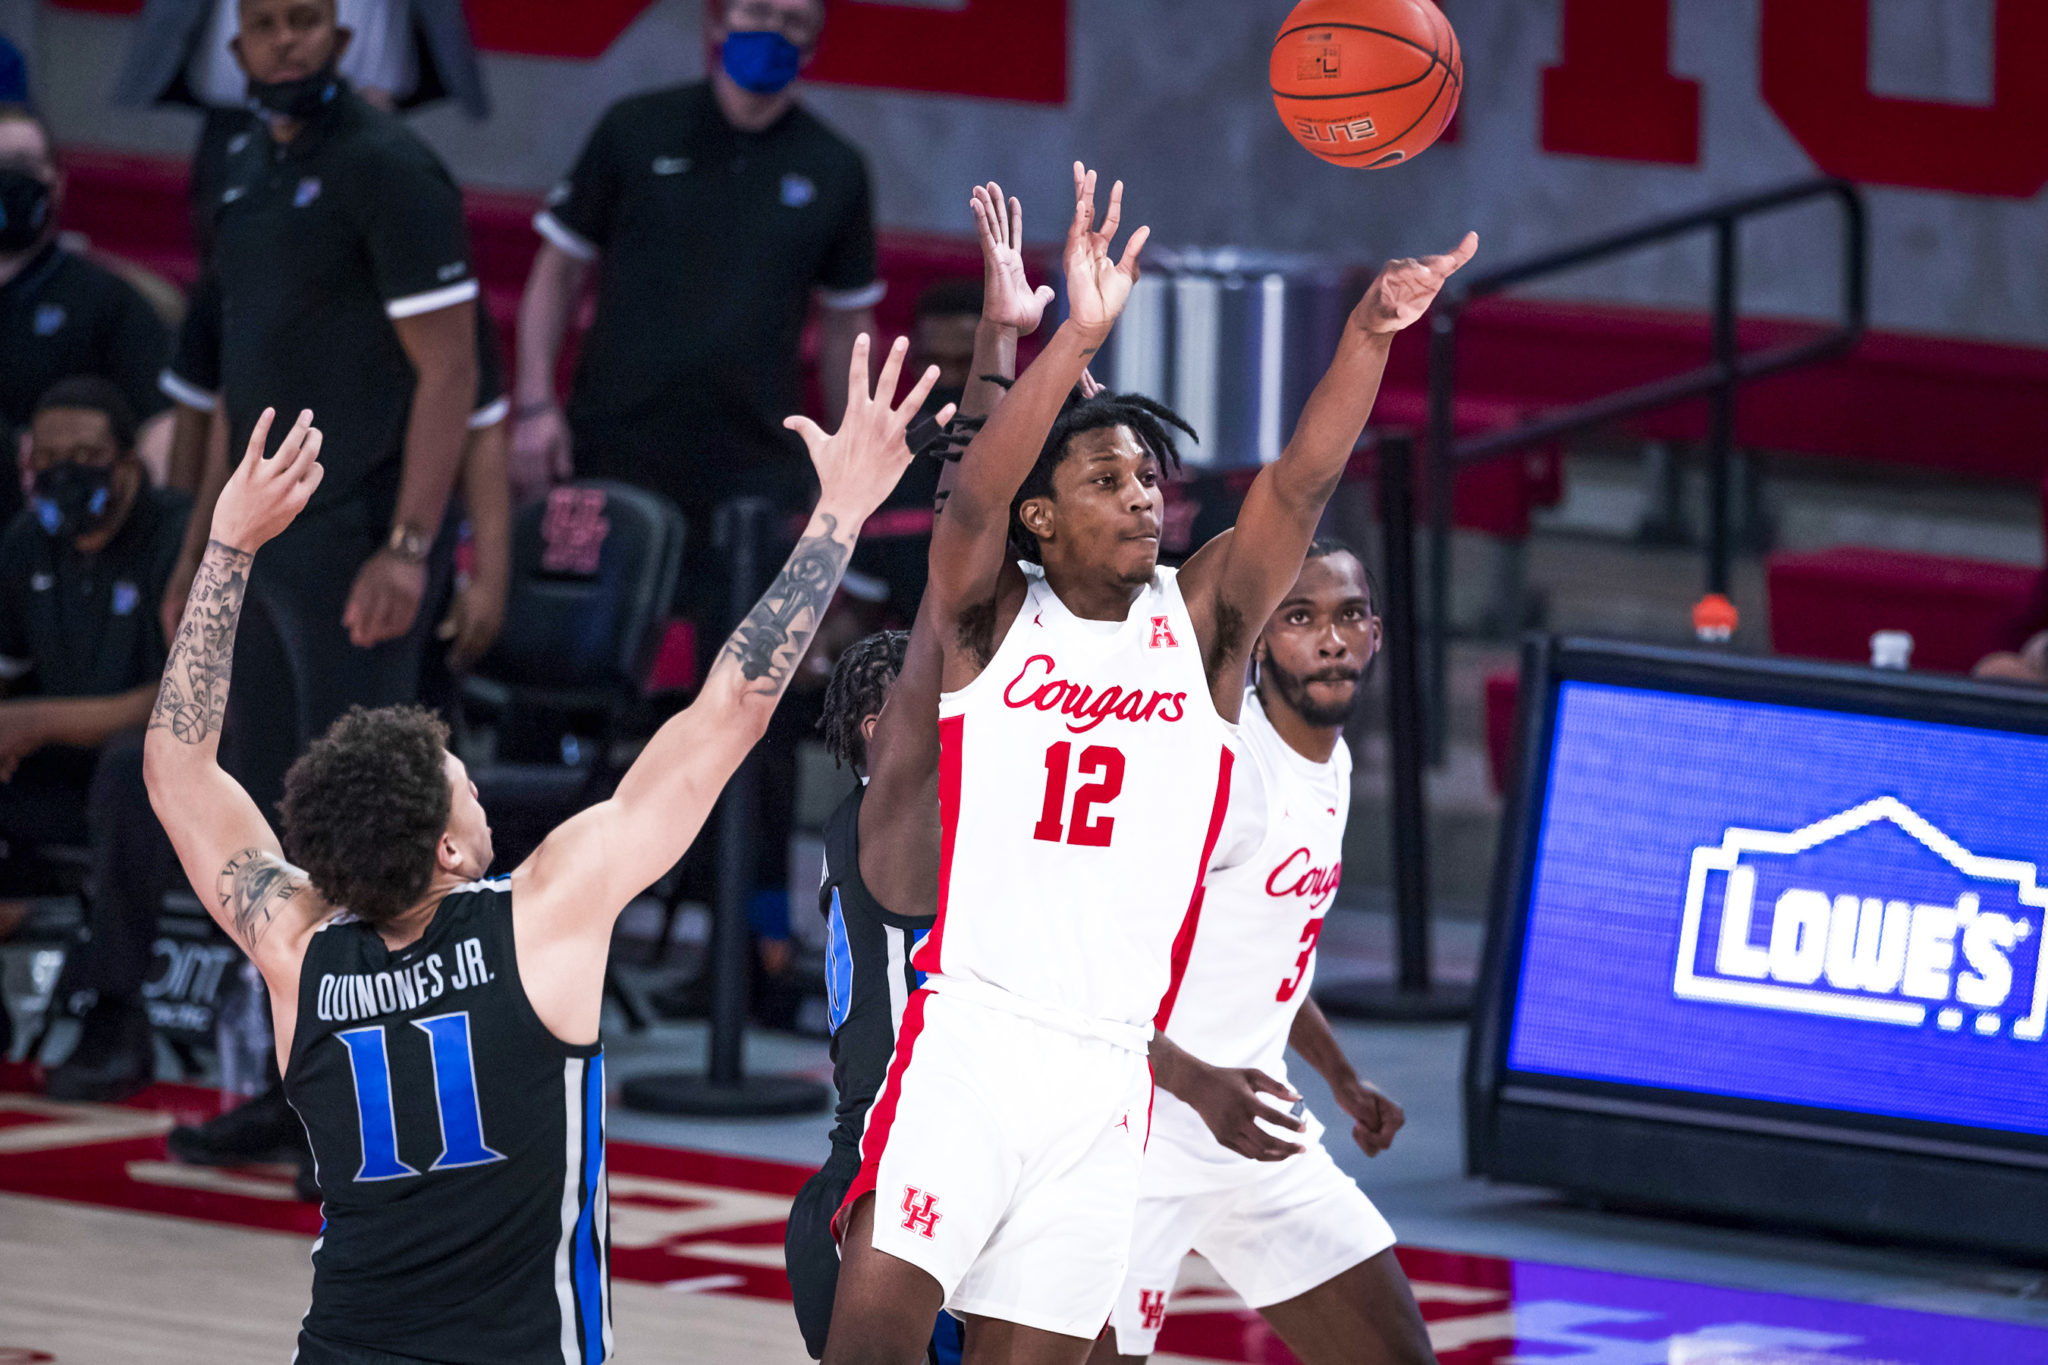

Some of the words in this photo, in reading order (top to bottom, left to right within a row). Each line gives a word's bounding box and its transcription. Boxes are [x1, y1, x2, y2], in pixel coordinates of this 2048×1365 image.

[1296, 117, 1378, 143] ELITE
[1149, 615, 1179, 649] A
[1003, 653, 1188, 734] Cougars
[1033, 740, 1126, 848] 12
[1275, 917, 1324, 1003] 3
[1715, 865, 2016, 1008] LOWE'S
[317, 953, 445, 1022] QUINONES
[451, 937, 495, 990] JR.
[332, 1010, 509, 1182] 11
[900, 1184, 943, 1241] UH
[1139, 1288, 1166, 1330] UH
